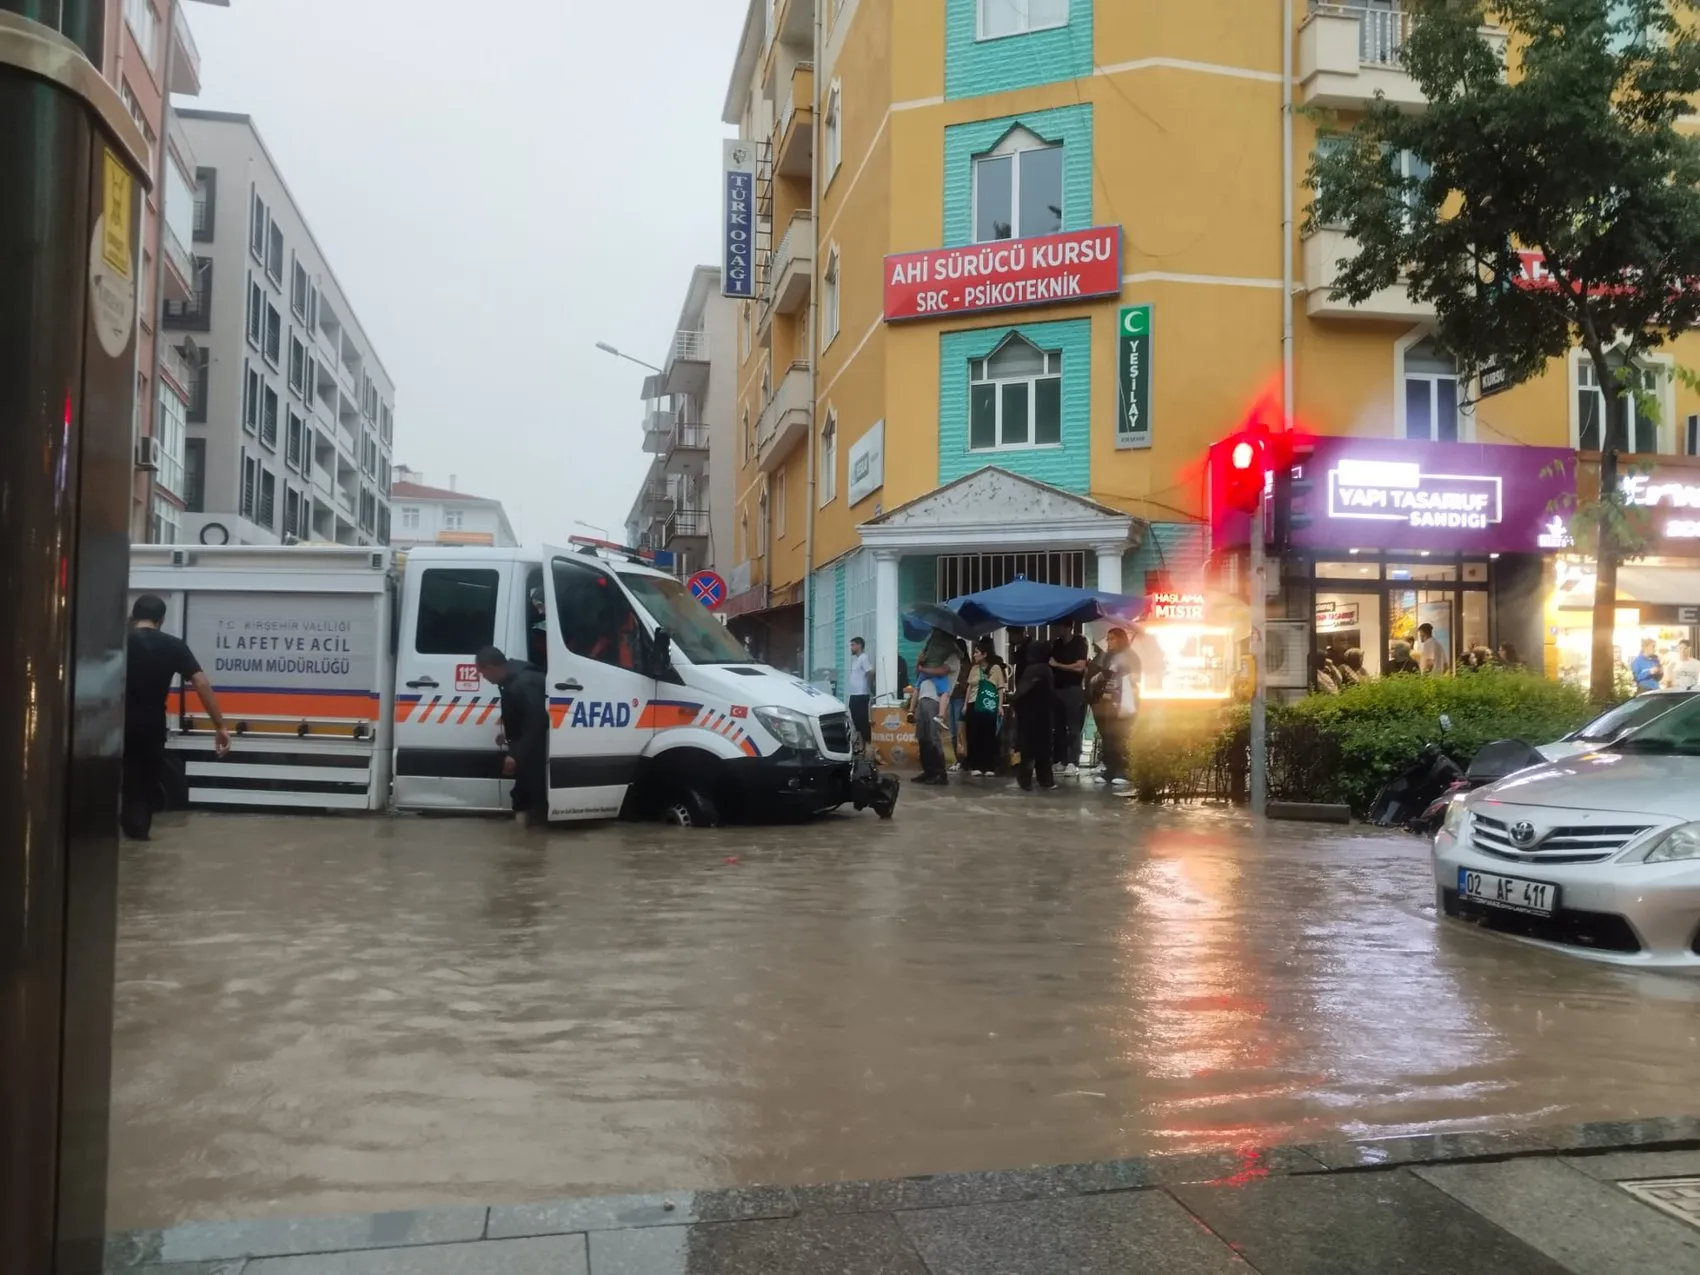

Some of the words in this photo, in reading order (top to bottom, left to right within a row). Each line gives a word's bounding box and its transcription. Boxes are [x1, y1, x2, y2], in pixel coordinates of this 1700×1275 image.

[730, 175, 748, 225] TÜRK
[729, 229, 747, 292] OCAĞI
[891, 256, 928, 286] AHİ
[934, 244, 1025, 281] SÜRÜCÜ
[1032, 237, 1112, 269] KURSU
[916, 289, 949, 312] SRC
[964, 272, 1081, 307] PSİKOTEKNİK
[1128, 340, 1139, 428] YEŞİLAY
[1338, 488, 1387, 508] YAPI
[1390, 490, 1489, 512] TASARRUF
[216, 632, 231, 649] İL
[236, 636, 279, 650] AFET
[284, 637, 305, 651] VE
[310, 635, 350, 652] ACİL
[215, 657, 263, 672] DURUM
[265, 656, 350, 675] MÜDÜRLÜĞÜ
[459, 667, 477, 680] 112
[571, 701, 631, 728] AFAD
[1466, 872, 1482, 896] 02
[1496, 878, 1513, 901] AF
[1523, 883, 1546, 908] 411
